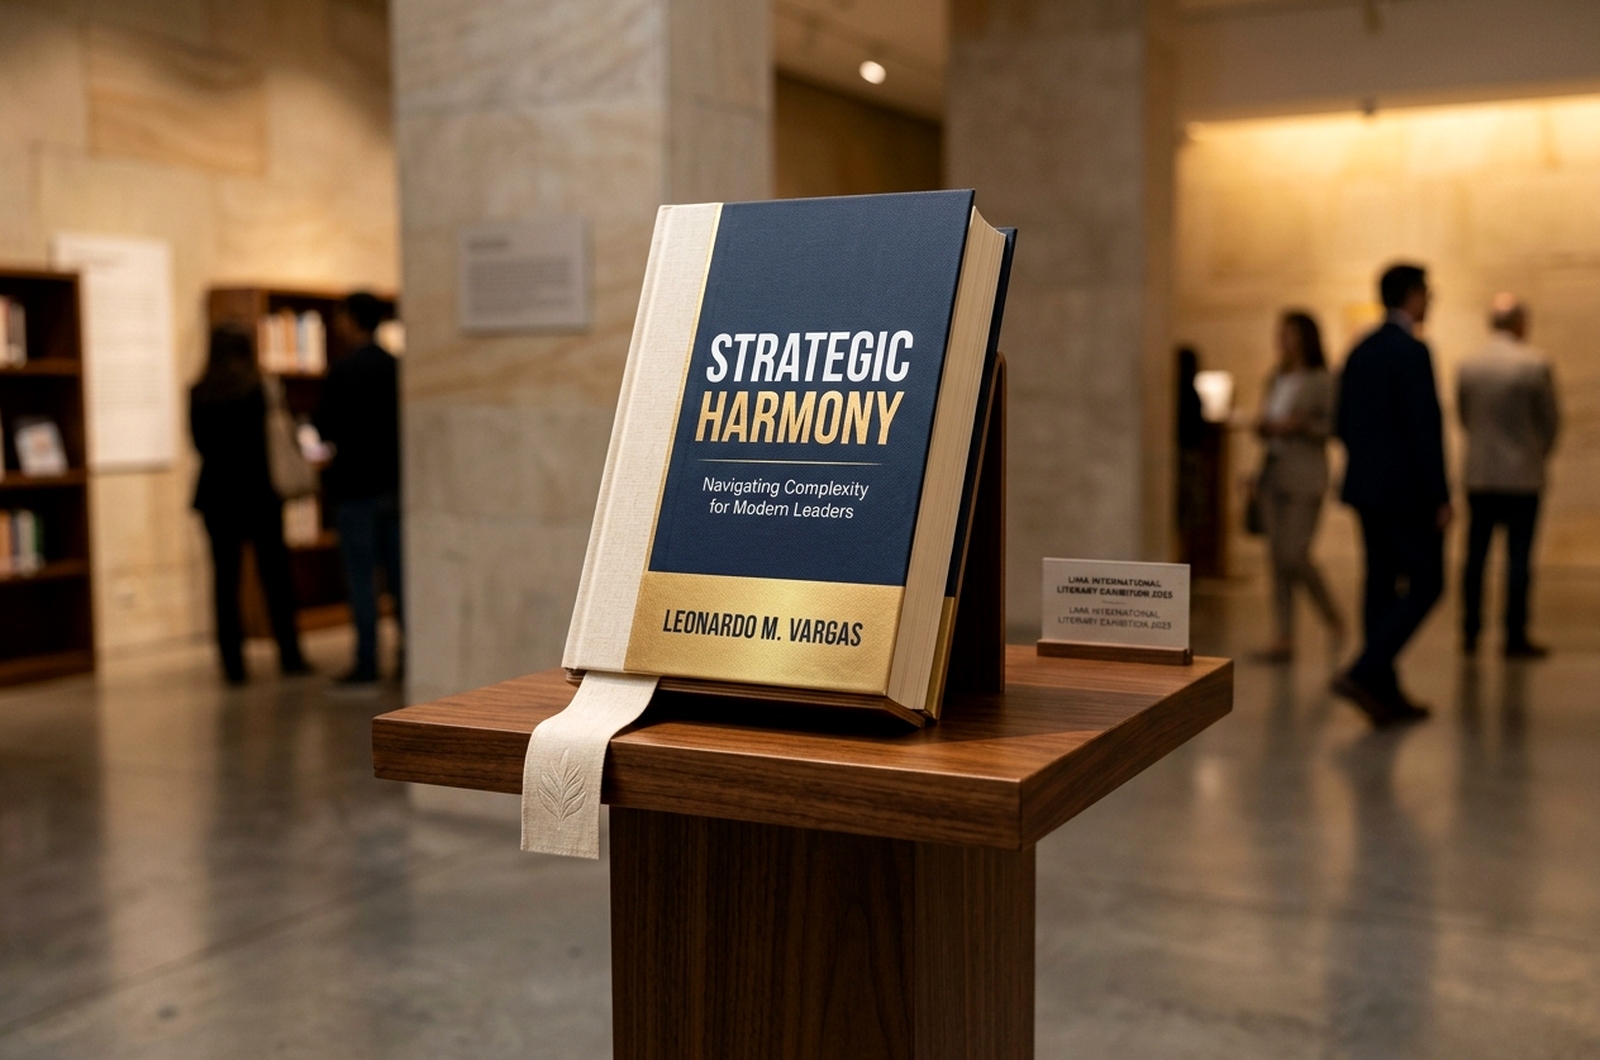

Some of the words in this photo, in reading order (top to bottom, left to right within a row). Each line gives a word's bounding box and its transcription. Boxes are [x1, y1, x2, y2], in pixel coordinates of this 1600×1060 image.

[705, 330, 914, 383] STRATEGIC
[695, 390, 905, 446] HARMONY
[702, 476, 781, 498] Navigating
[784, 479, 869, 501] Complexity
[709, 498, 730, 514] for
[733, 500, 789, 516] Modern
[793, 502, 854, 519] Leaders
[662, 609, 757, 639] LEONARDO
[760, 616, 781, 641] M.
[789, 618, 863, 647] VARGAS
